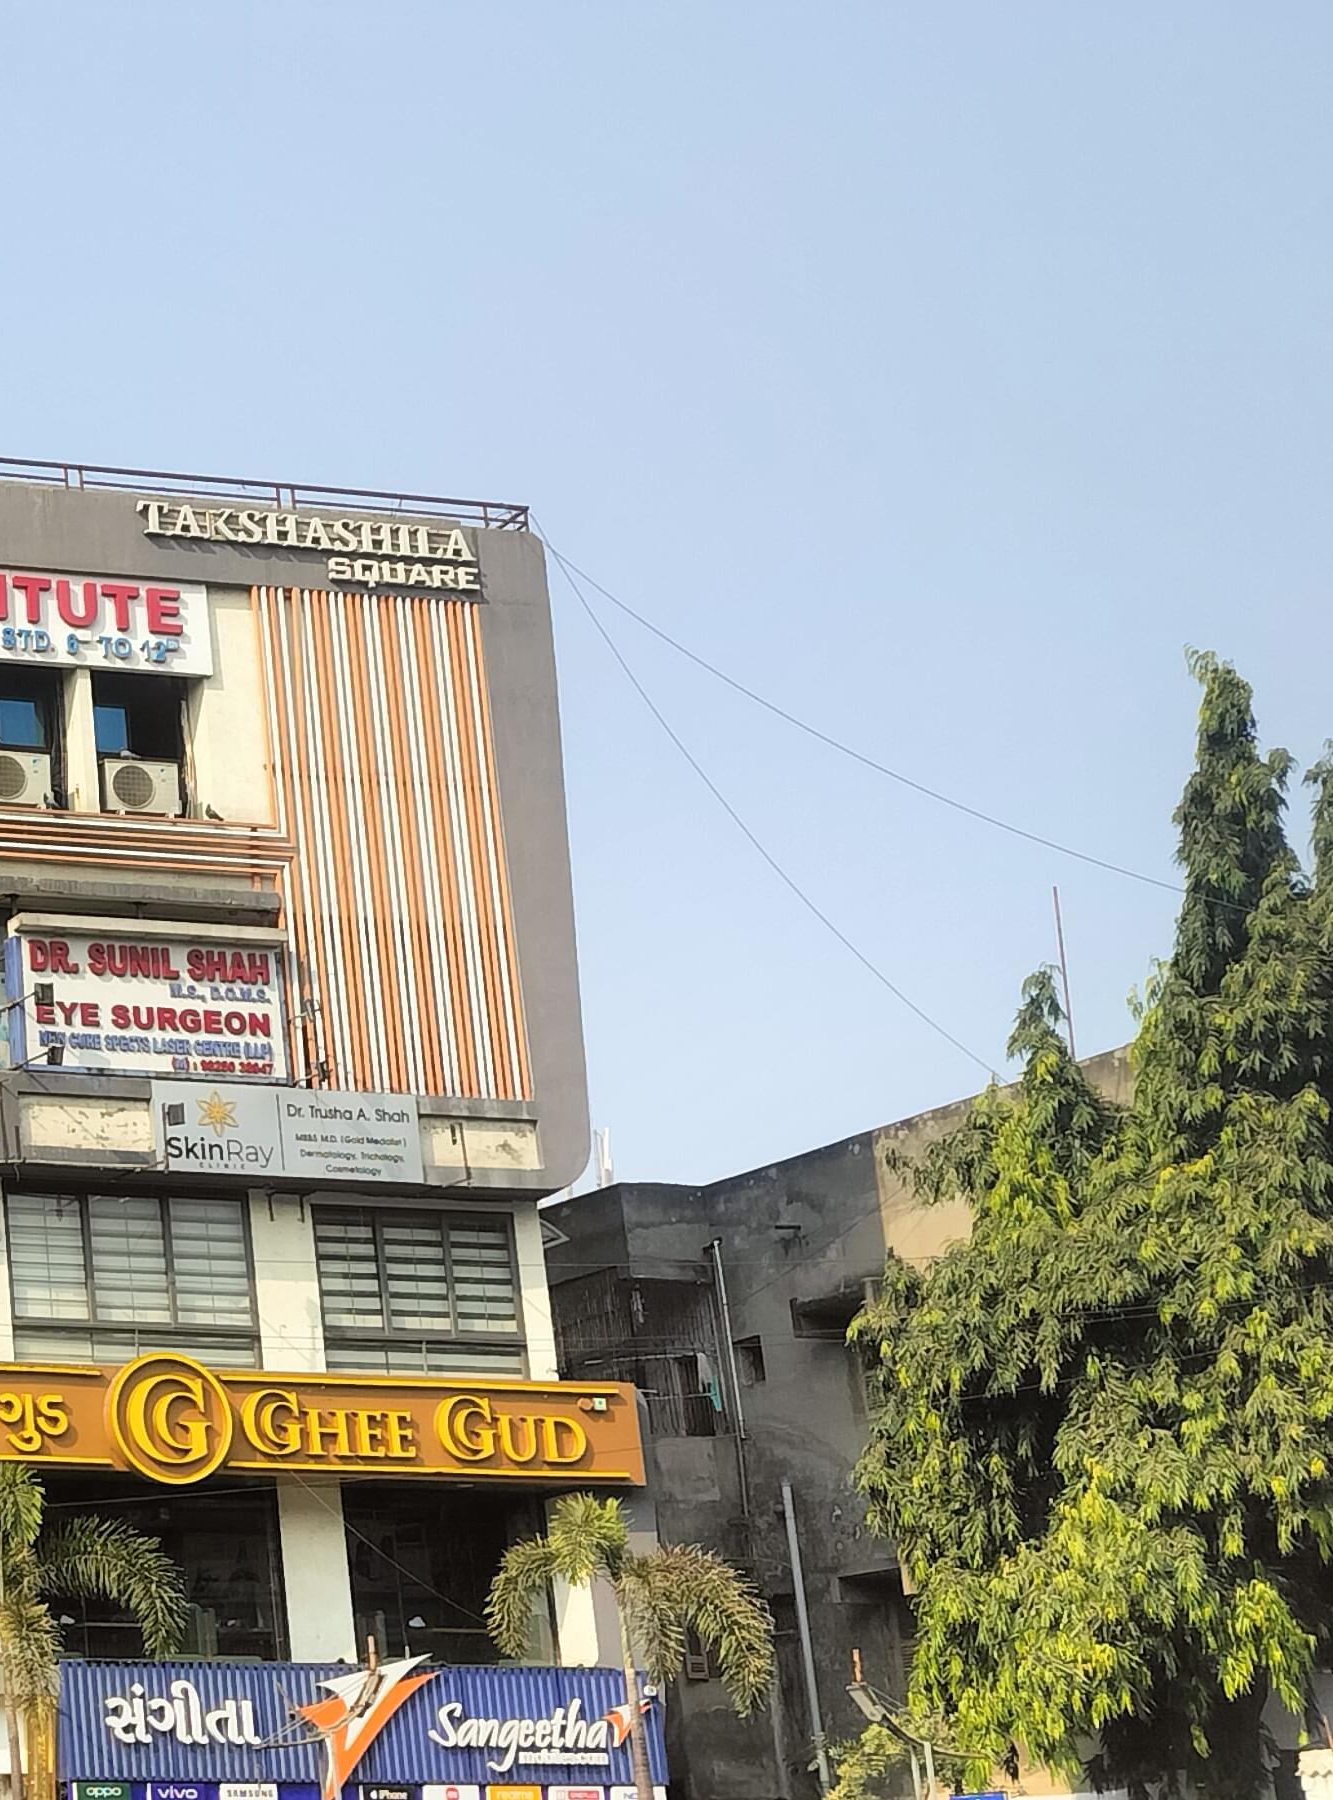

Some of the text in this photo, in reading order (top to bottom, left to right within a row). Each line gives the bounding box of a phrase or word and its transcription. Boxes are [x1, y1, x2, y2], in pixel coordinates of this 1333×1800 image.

[135, 499, 477, 562] TAKSHASHILA
[327, 556, 481, 590] SQUARE
[1, 627, 56, 653] STD.
[97, 635, 132, 659] TO
[27, 939, 271, 986] DR. SUNIL SHAH
[35, 1001, 272, 1038] EYE SURGEON
[286, 1103, 411, 1124] Dr. Trusha A. Shah
[166, 1136, 274, 1169] SkinRay
[325, 1163, 382, 1177] Cosmetology
[241, 1389, 587, 1464] GHEE GUD
[104, 1678, 263, 1746] સંગીતા
[428, 1698, 609, 1773] Sangeetha
[85, 1786, 123, 1799] oppo
[156, 1785, 199, 1800] vivo
[226, 1788, 274, 1799] SAMSUNG
